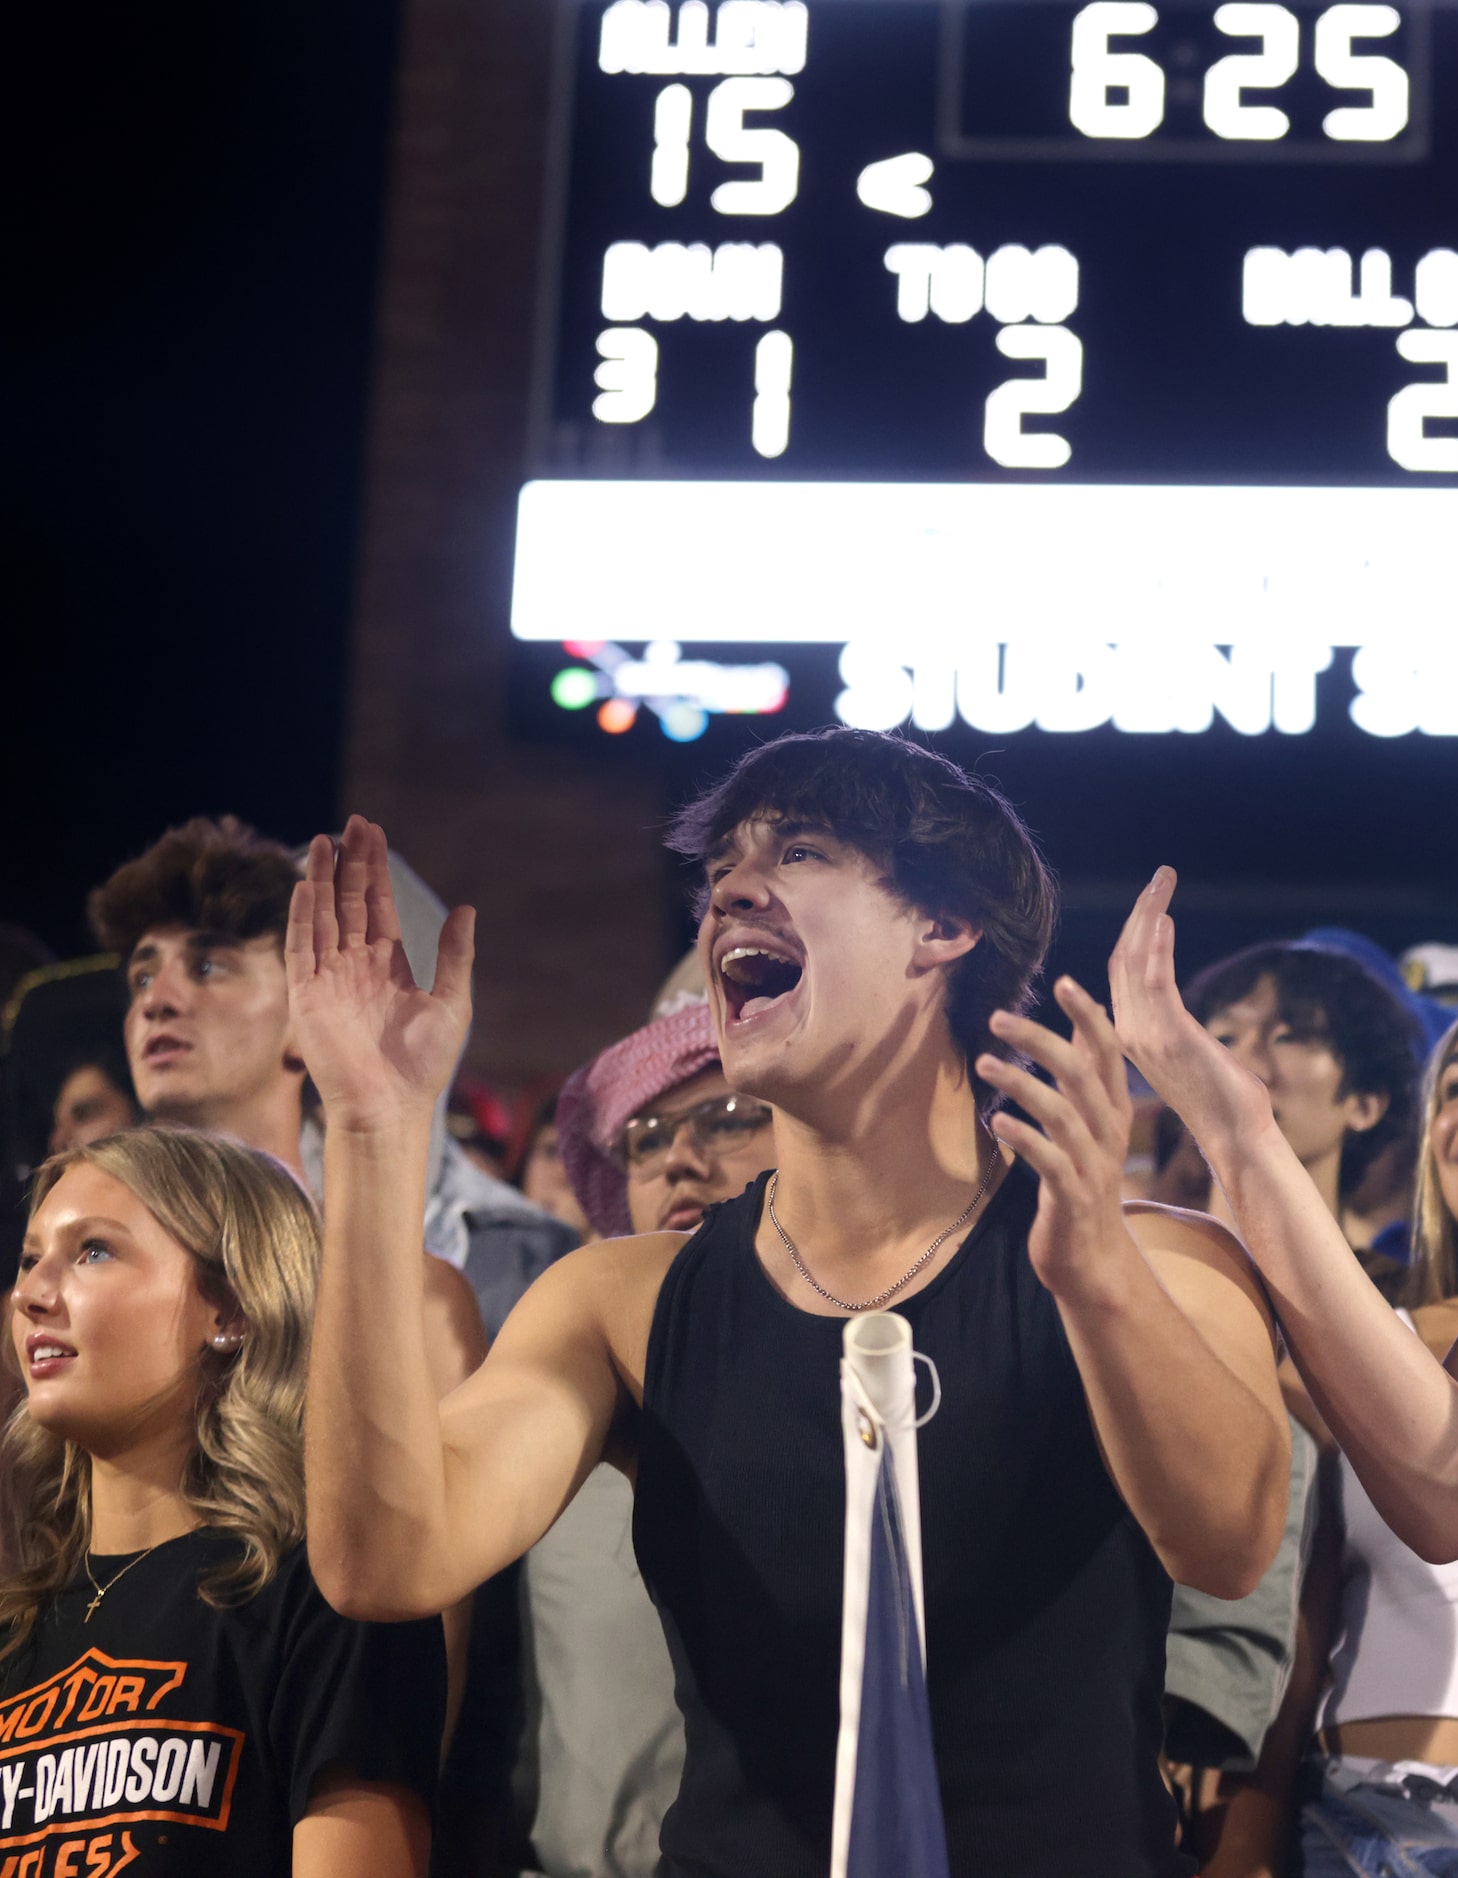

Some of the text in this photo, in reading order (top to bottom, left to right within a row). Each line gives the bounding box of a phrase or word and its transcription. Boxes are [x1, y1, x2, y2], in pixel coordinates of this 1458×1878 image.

[598, 0, 808, 74] ALLEN
[651, 76, 800, 215] 15
[592, 327, 658, 423] 3
[752, 330, 793, 458] 1
[983, 324, 1083, 469] 2
[834, 634, 1333, 734] STUDENT
[0, 1736, 222, 1830] Y-DAVIDSON
